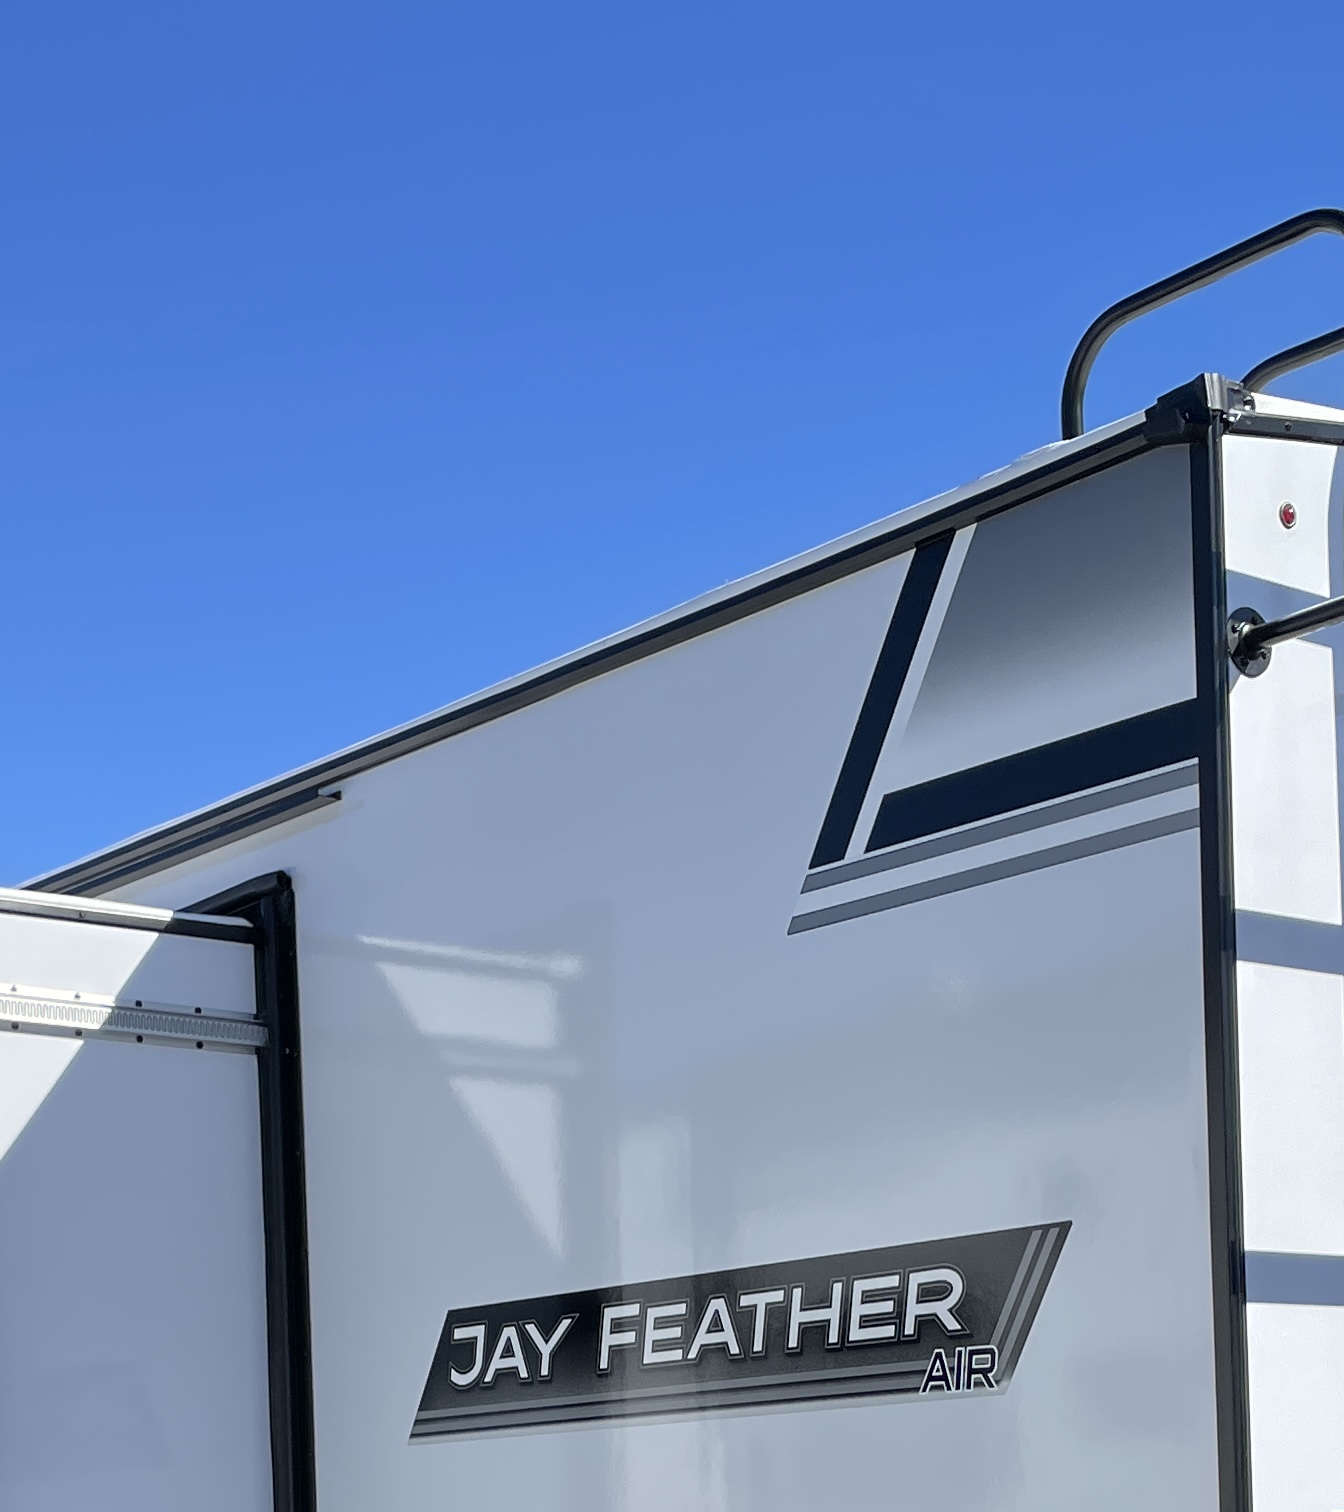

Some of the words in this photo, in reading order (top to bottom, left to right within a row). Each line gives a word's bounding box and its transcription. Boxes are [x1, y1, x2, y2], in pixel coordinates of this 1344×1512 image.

[448, 1314, 577, 1389] JAY
[597, 1264, 969, 1374] FEATHER
[919, 1345, 999, 1395] AIR
